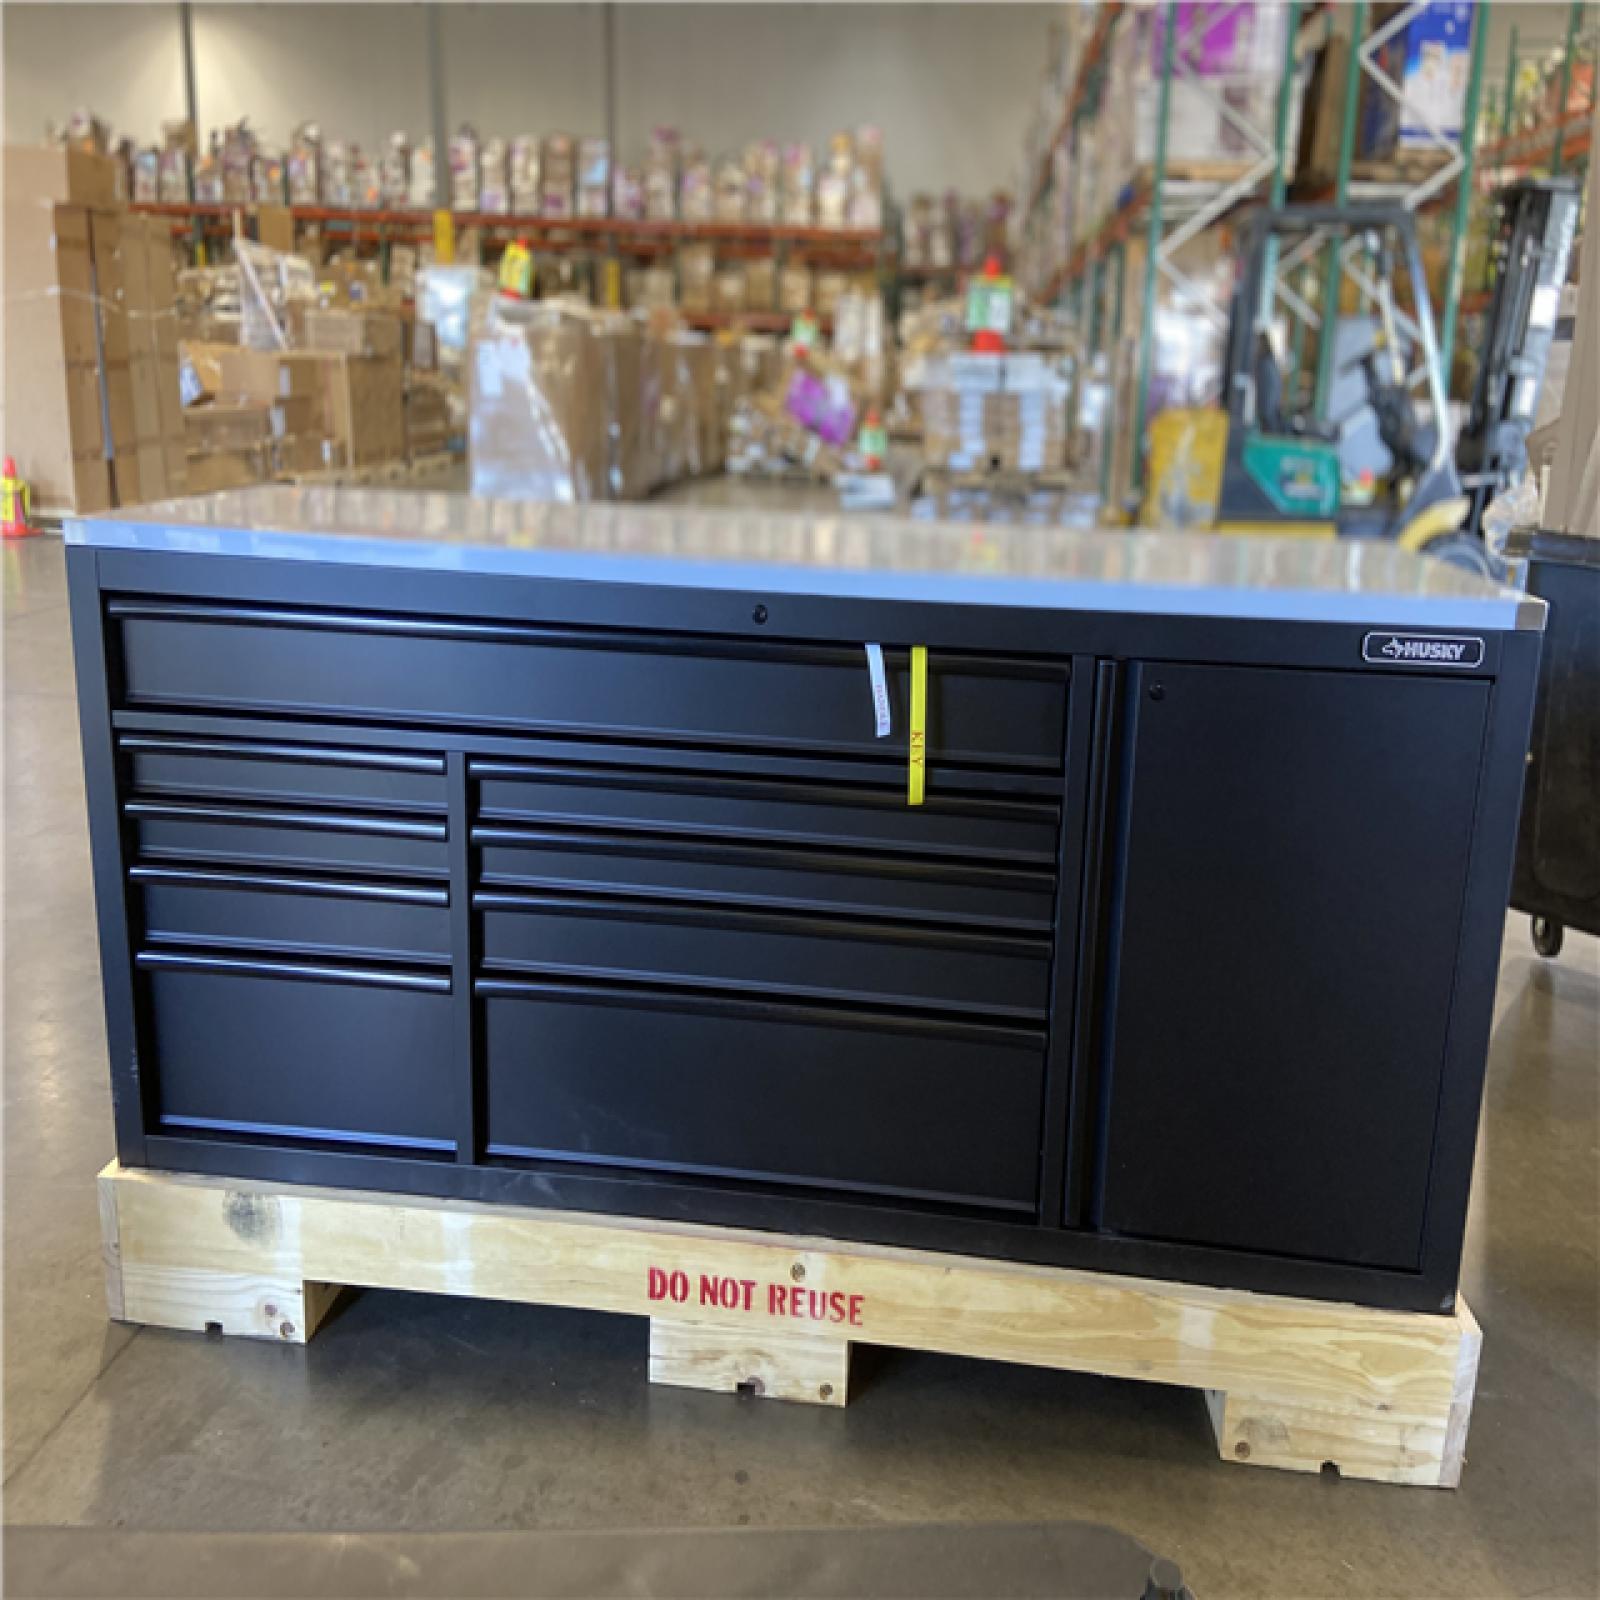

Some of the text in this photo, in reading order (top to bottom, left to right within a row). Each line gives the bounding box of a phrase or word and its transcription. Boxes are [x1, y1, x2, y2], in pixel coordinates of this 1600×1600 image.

[1404, 641, 1465, 660] HUSKY
[648, 1267, 866, 1327] DO NOT REUSE
